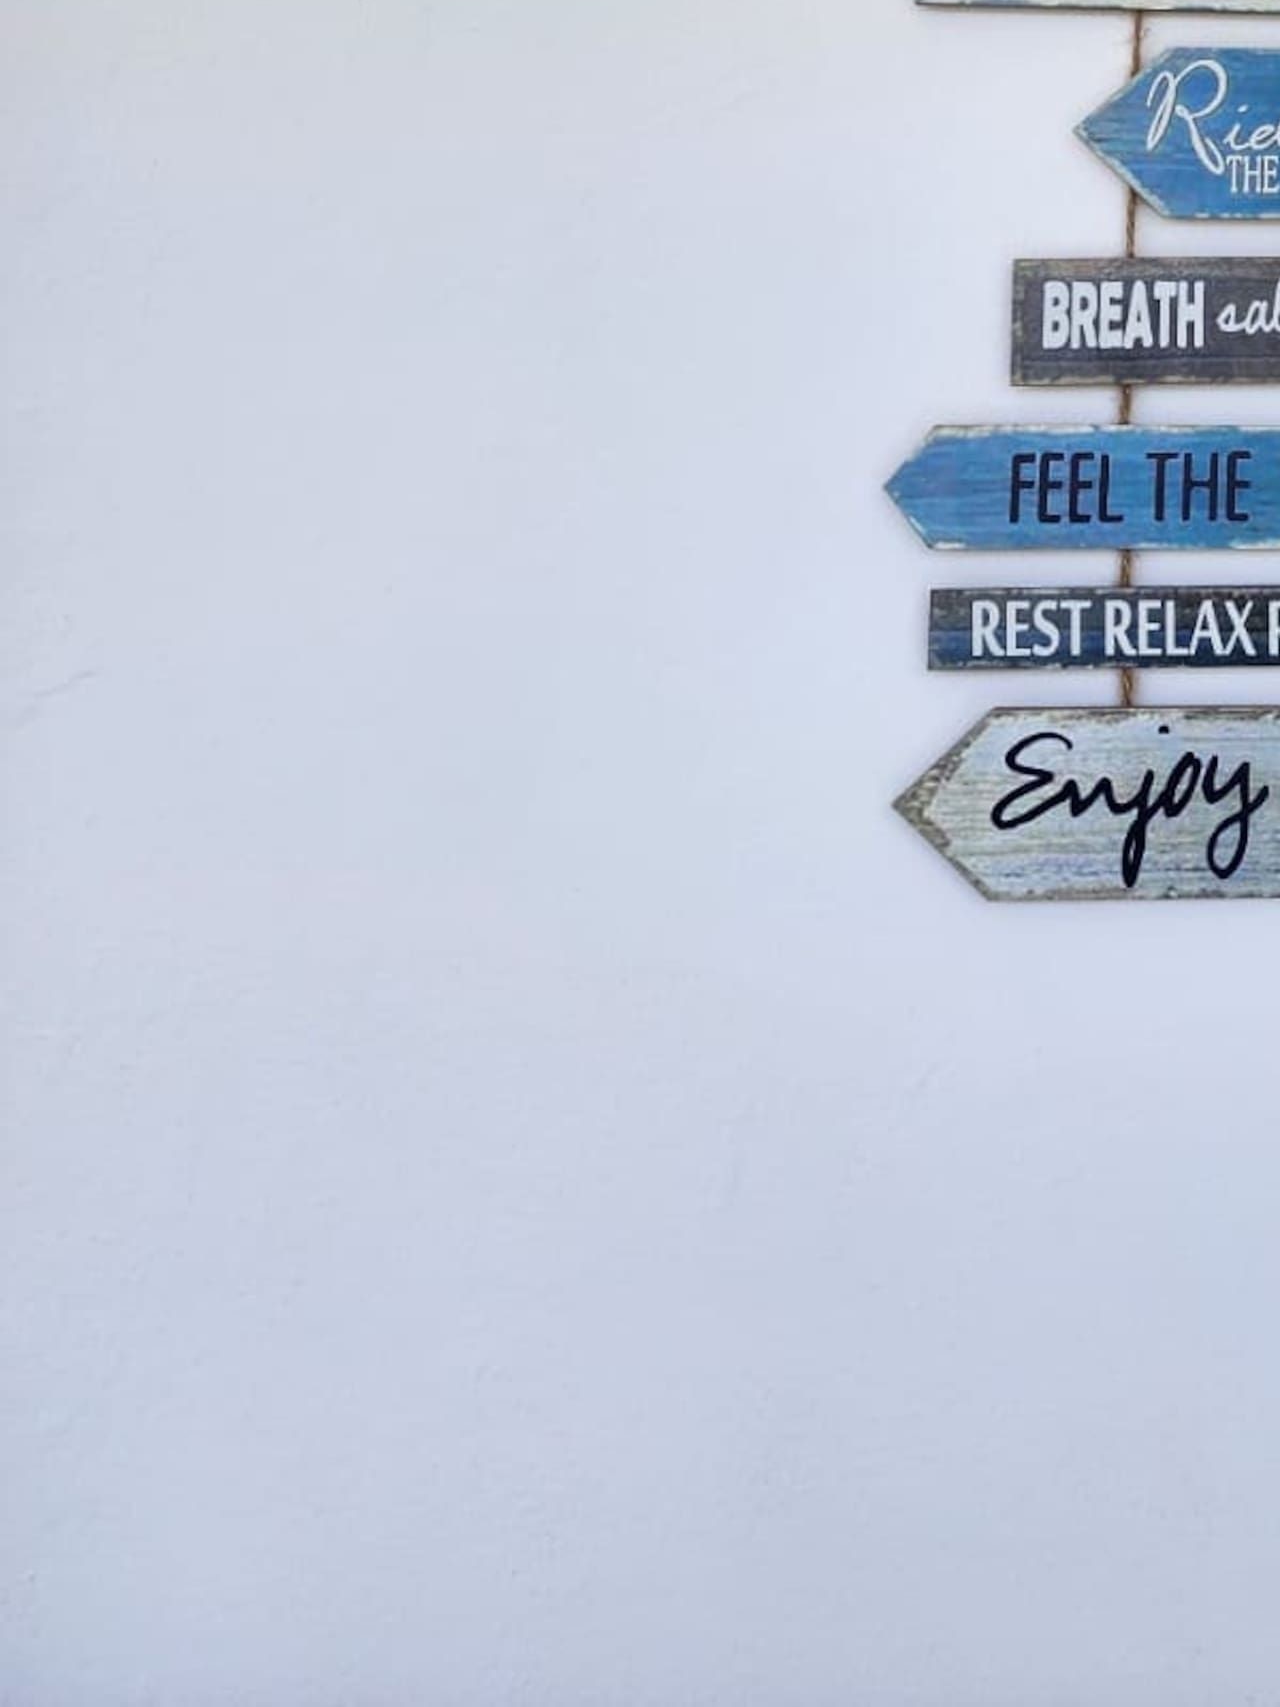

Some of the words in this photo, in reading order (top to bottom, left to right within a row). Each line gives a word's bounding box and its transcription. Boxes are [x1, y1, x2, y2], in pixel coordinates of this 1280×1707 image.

[1225, 155, 1280, 194] THE
[1041, 280, 1205, 350] BREATH
[1008, 452, 1124, 524] FEEL
[1145, 450, 1252, 522] THE
[971, 599, 1092, 658] REST
[1103, 600, 1257, 658] RELAX
[990, 725, 1269, 887] Enjoy
